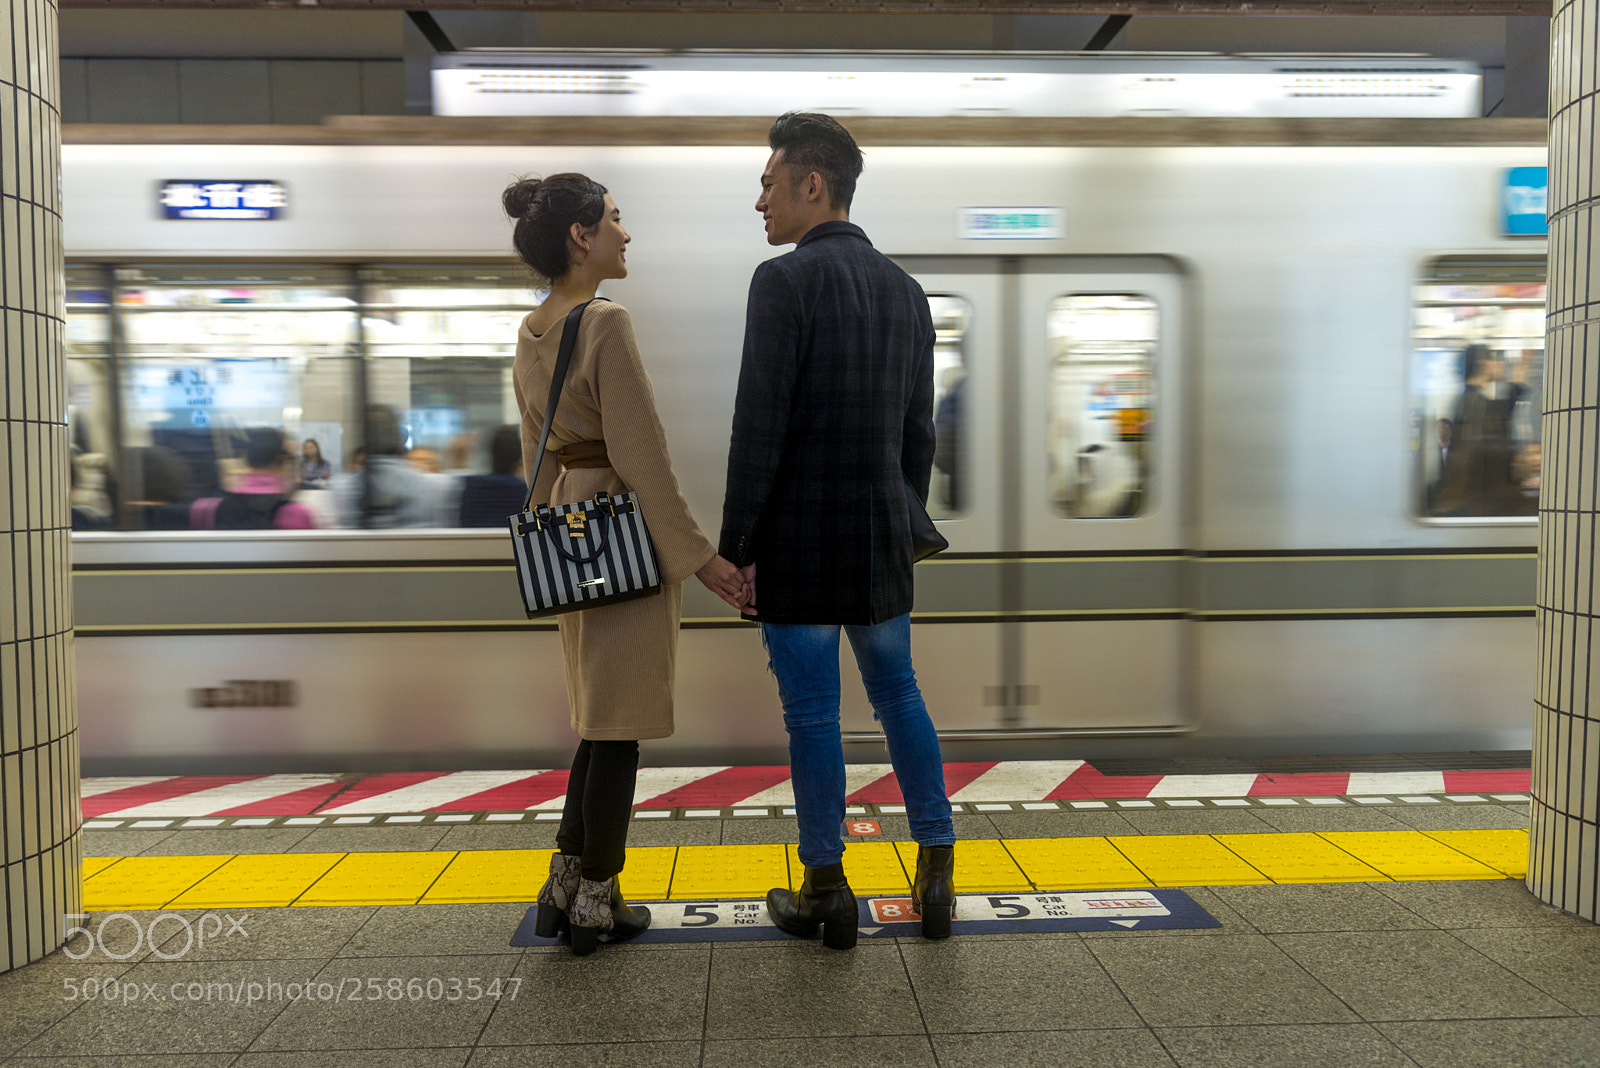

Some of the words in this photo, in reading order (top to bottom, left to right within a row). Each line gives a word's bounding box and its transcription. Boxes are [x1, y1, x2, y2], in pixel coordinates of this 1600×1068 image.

[853, 822, 875, 833] 8
[681, 904, 720, 927] 5
[881, 904, 903, 917] 8
[986, 896, 1031, 919] 5
